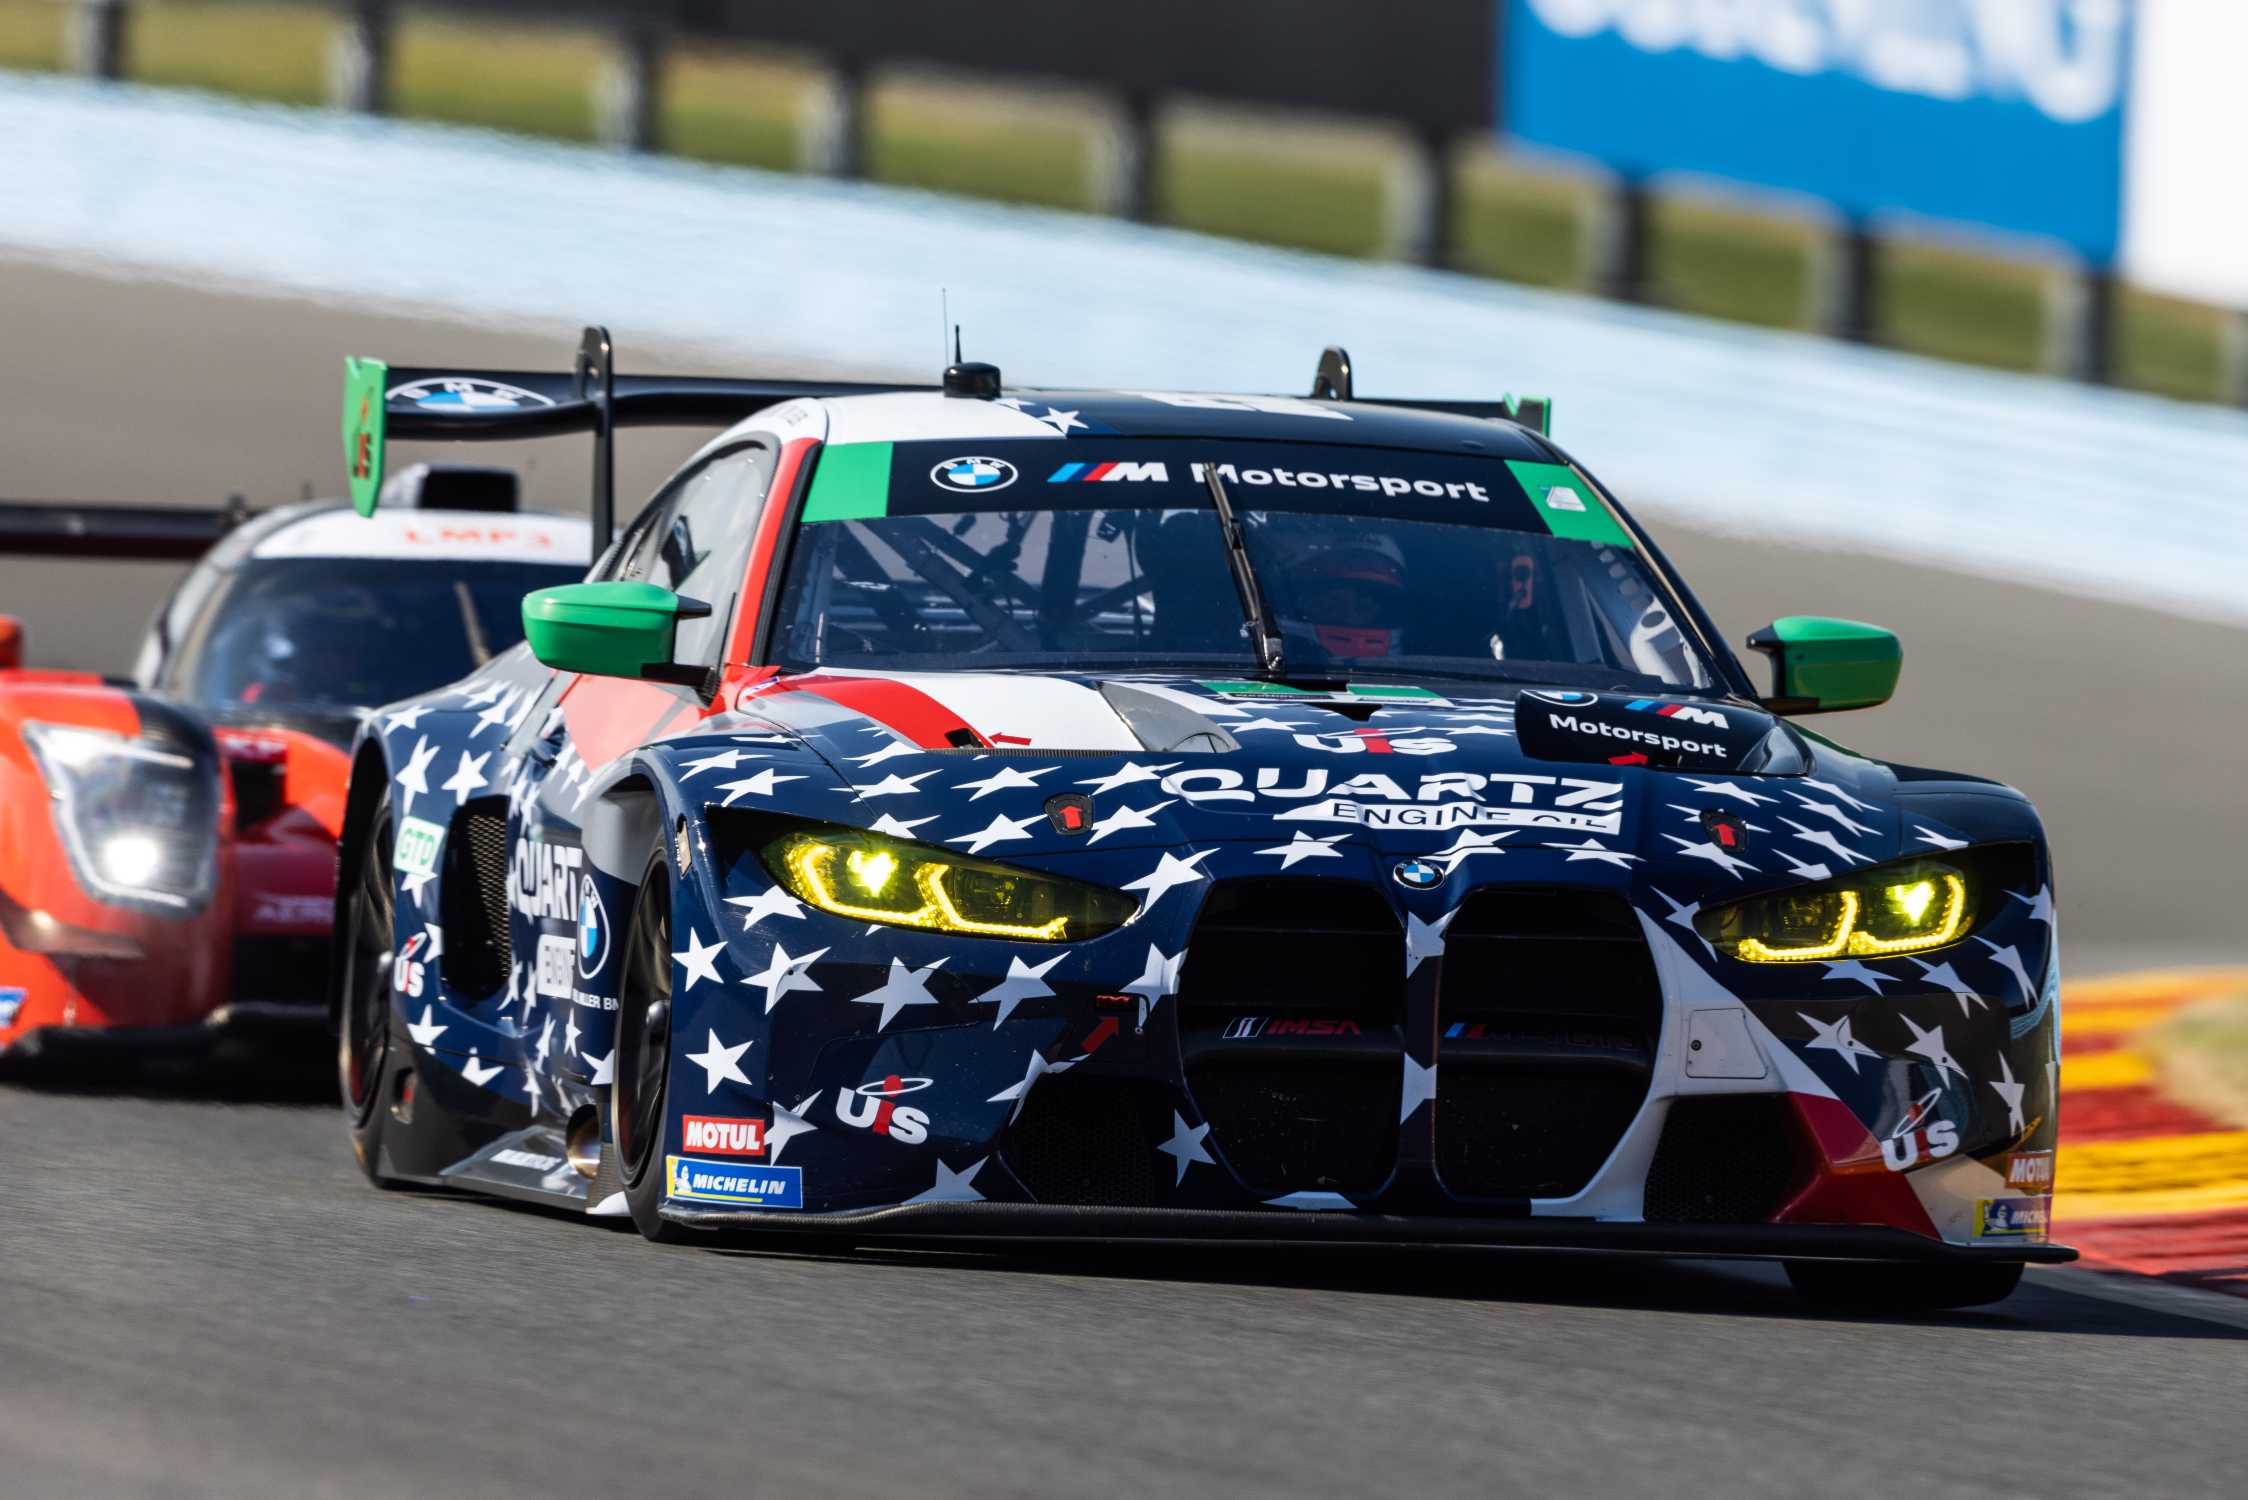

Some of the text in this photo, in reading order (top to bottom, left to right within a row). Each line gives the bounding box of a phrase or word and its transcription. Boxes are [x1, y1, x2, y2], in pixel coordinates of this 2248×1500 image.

[1190, 462, 1490, 502] Motorsport
[1549, 713, 1728, 758] Motorsport
[1161, 767, 1624, 809] QUARTZ
[1333, 802, 1511, 827] ENGINE
[1266, 1019, 1360, 1035] IMSA
[686, 1120, 761, 1150] MOTUL
[693, 1173, 787, 1195] MICHELIN
